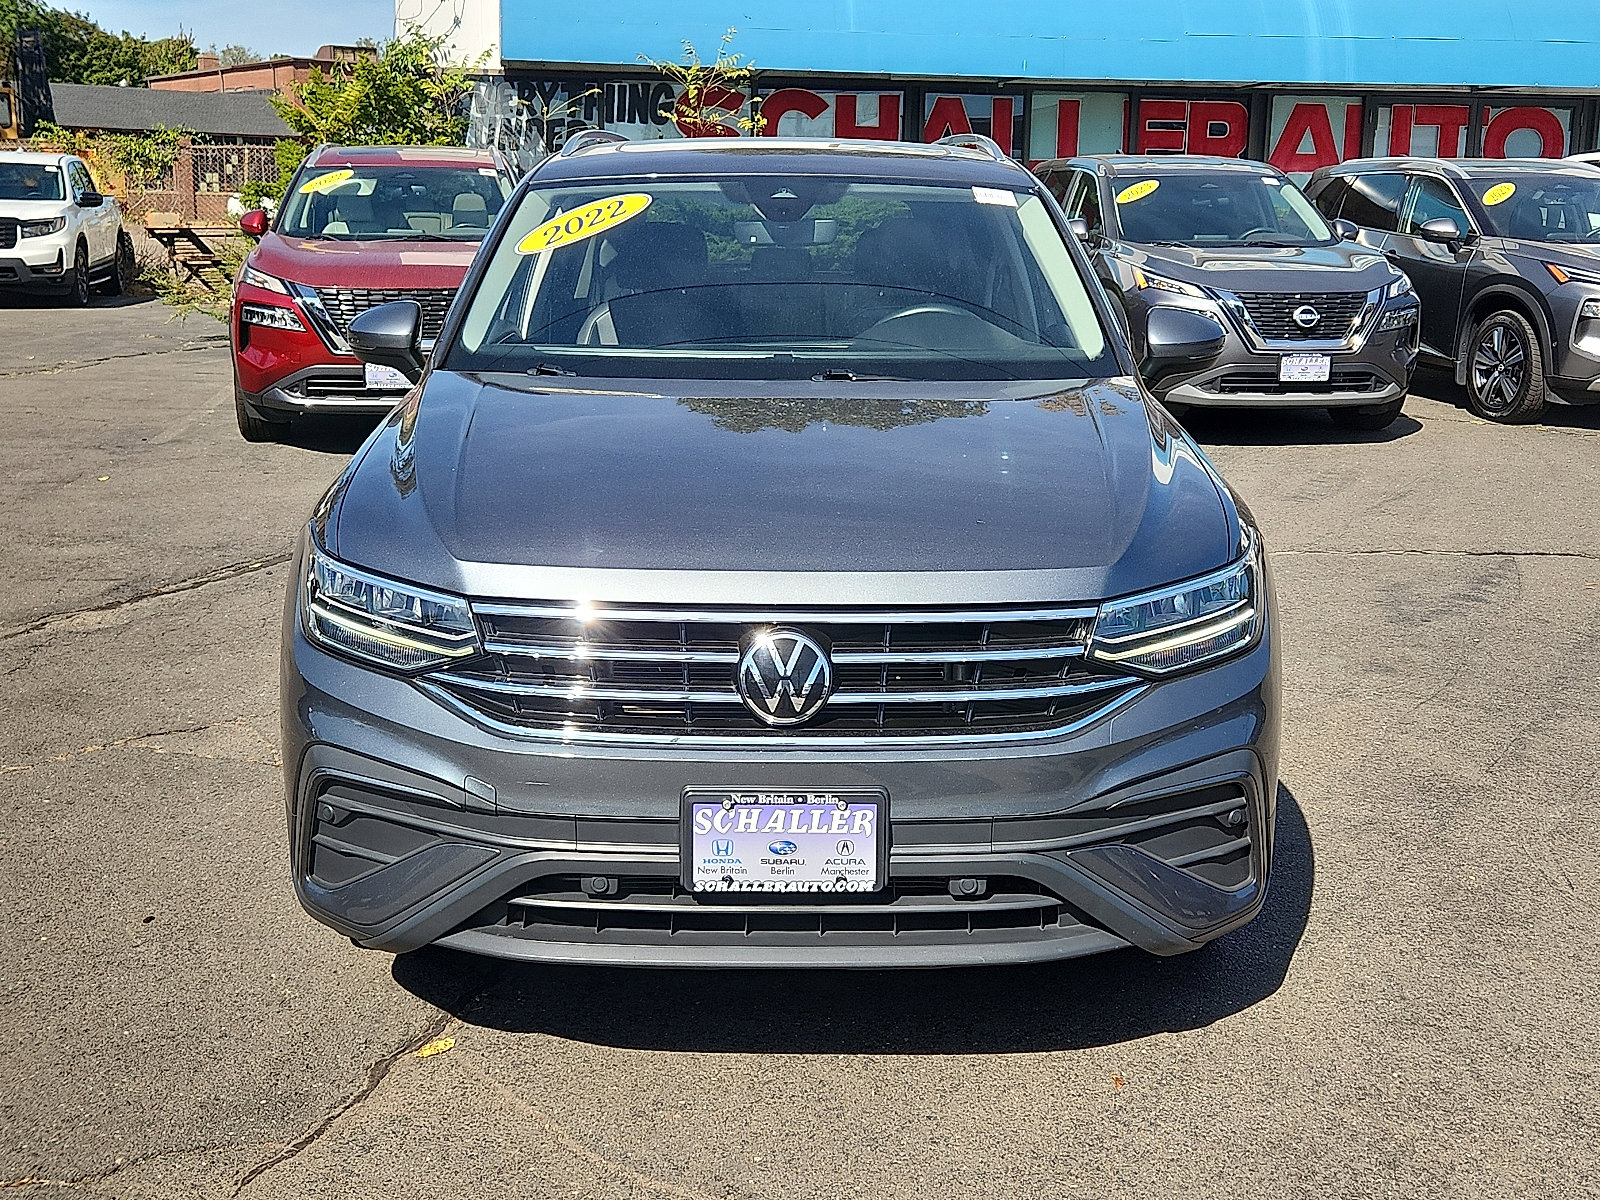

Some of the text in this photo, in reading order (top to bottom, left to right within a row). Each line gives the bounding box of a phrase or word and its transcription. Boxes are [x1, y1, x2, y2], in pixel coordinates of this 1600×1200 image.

[1267, 103, 1565, 172] AUTO
[543, 200, 627, 247] 2022
[731, 794, 839, 804] New Britain Berlin
[694, 807, 874, 838] SCHALLER
[824, 858, 866, 866] ACURA
[697, 865, 748, 875] New Britain
[770, 866, 795, 875] Berlin
[820, 866, 870, 876] Manchester
[693, 880, 876, 893] SCHALLERAUTO.COM
